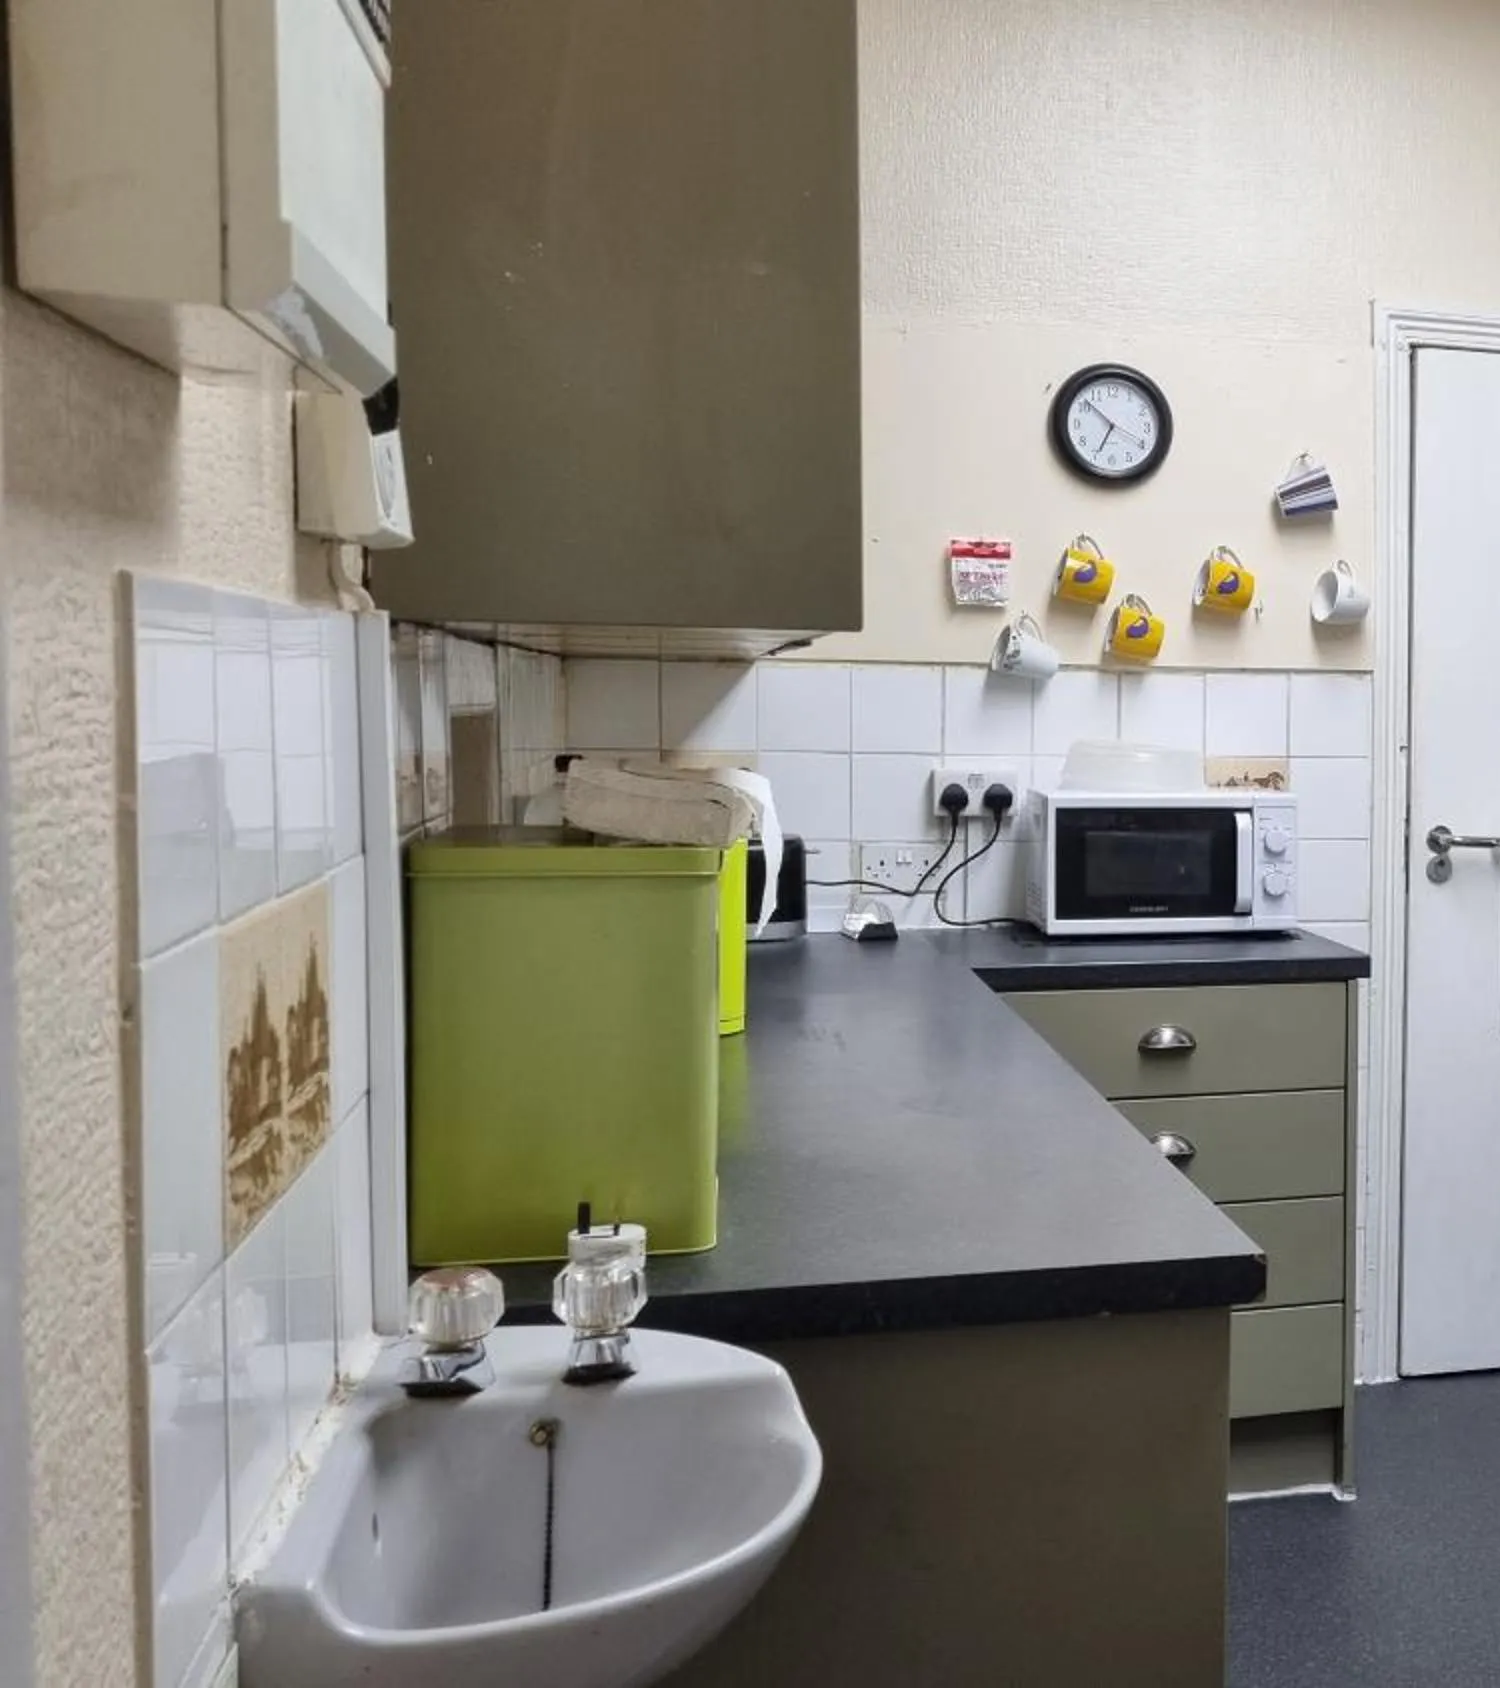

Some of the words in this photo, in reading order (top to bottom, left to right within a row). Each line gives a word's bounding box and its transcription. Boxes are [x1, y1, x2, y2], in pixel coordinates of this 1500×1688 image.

[1091, 389, 1102, 402] 11
[1107, 385, 1119, 398] 12
[1127, 388, 1133, 401] 1
[1078, 401, 1091, 413] 10
[1139, 404, 1148, 417] 2
[1143, 422, 1151, 434] 3
[1079, 435, 1087, 446] 8
[1137, 439, 1145, 450] 4
[1091, 449, 1100, 462] 7
[1125, 451, 1133, 463] 5
